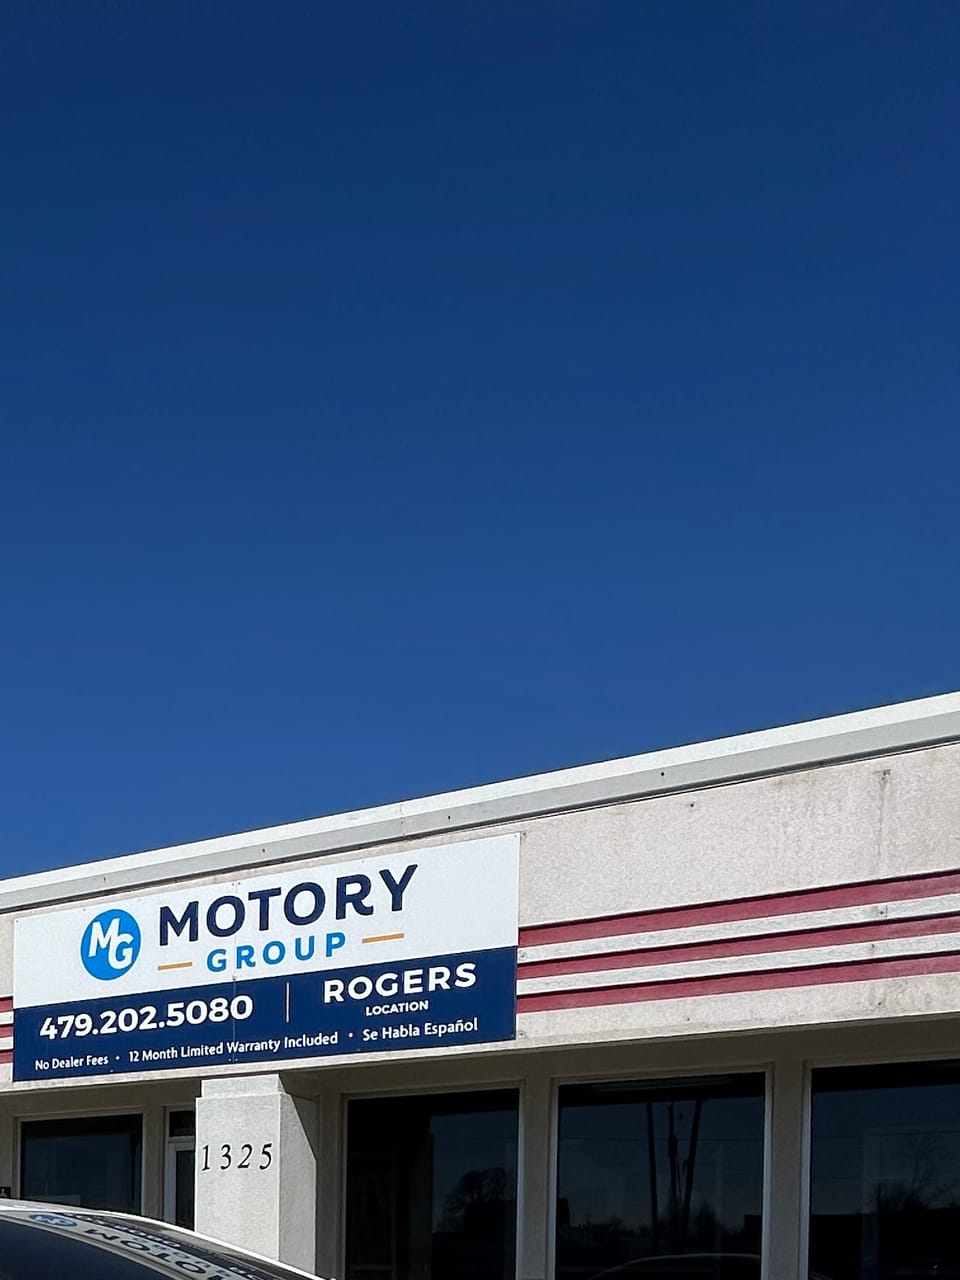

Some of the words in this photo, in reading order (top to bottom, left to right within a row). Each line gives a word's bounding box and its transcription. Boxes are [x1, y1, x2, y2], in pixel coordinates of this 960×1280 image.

[158, 863, 419, 947] MOTORY
[87, 916, 135, 971] MG
[206, 931, 347, 973] GROUP
[323, 962, 478, 1004] ROGERS
[39, 994, 254, 1040] 479.202.5080
[365, 1000, 429, 1017] LOCATION
[35, 1059, 49, 1071] No
[51, 1057, 85, 1070] Dealer
[86, 1055, 109, 1067] Fees
[129, 1051, 140, 1063] 12
[142, 1047, 178, 1062] Month
[180, 1042, 224, 1058] Limited
[226, 1037, 281, 1054] Warranty
[283, 1031, 339, 1049] Included
[362, 1028, 379, 1042] Se
[381, 1023, 420, 1040] Habla
[423, 1017, 478, 1037] Español
[201, 1143, 272, 1172] 1325
